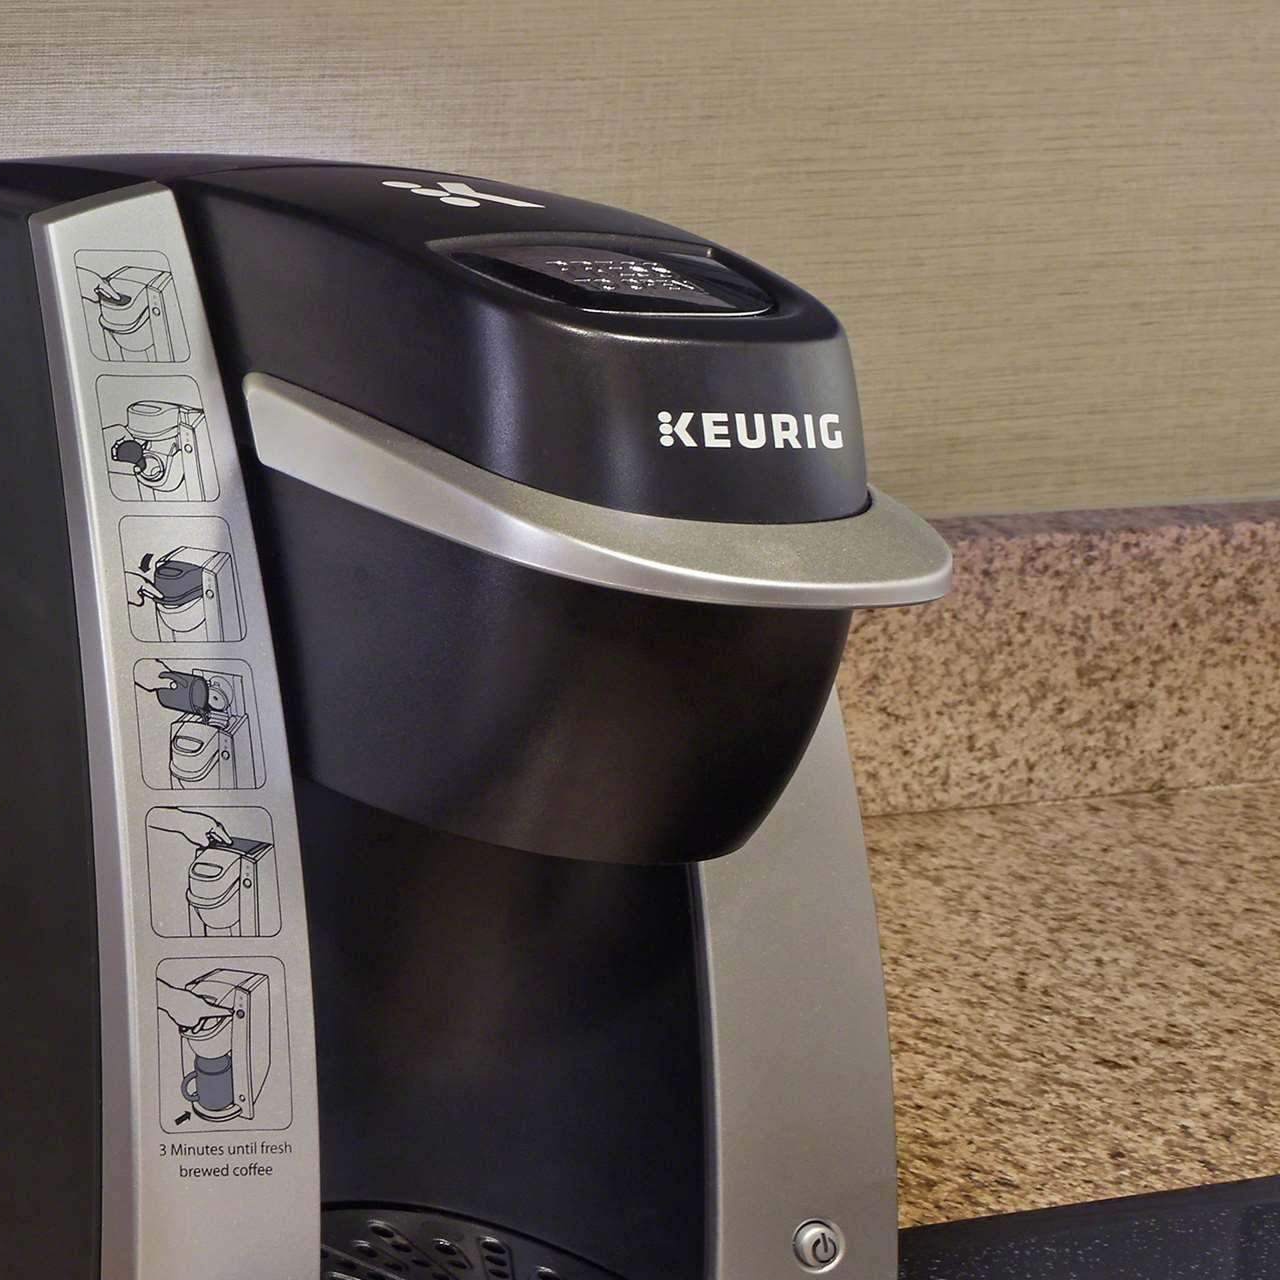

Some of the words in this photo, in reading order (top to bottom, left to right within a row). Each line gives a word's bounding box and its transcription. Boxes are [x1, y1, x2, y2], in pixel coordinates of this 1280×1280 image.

[658, 410, 844, 451] KEURIG
[158, 1143, 168, 1157] 3
[170, 1142, 225, 1158] Minutes
[227, 1141, 259, 1156] until
[259, 1140, 294, 1156] fresh
[179, 1162, 231, 1179] brewed
[232, 1162, 274, 1178] coffee
